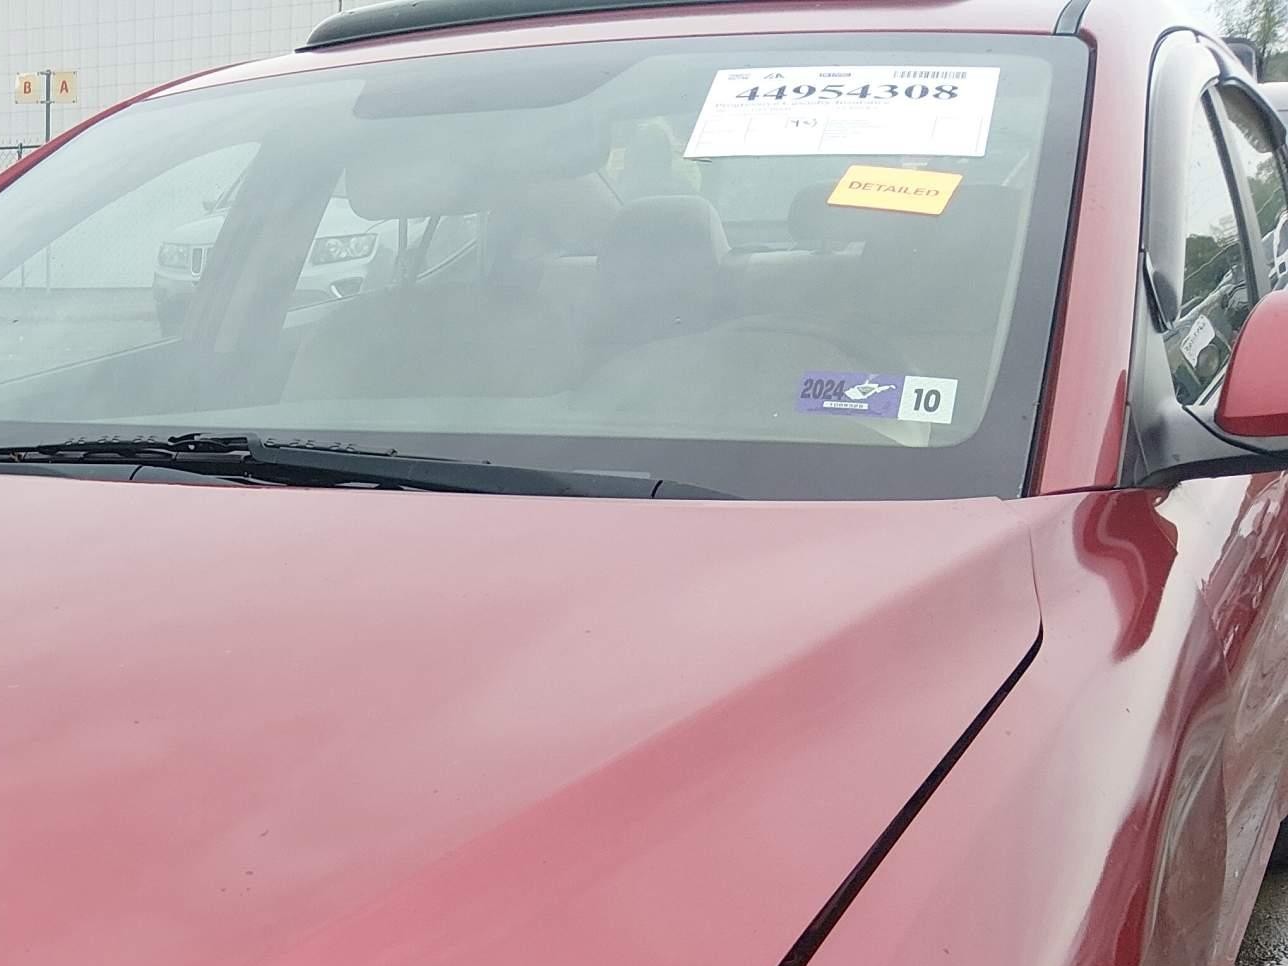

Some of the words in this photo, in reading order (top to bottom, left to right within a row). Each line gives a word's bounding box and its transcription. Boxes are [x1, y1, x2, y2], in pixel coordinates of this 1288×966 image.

[24, 81, 32, 94] B
[60, 80, 69, 94] A
[735, 83, 959, 101] 44954308
[848, 181, 940, 197] DETAILED
[800, 379, 845, 400] 2024
[913, 388, 941, 413] 10
